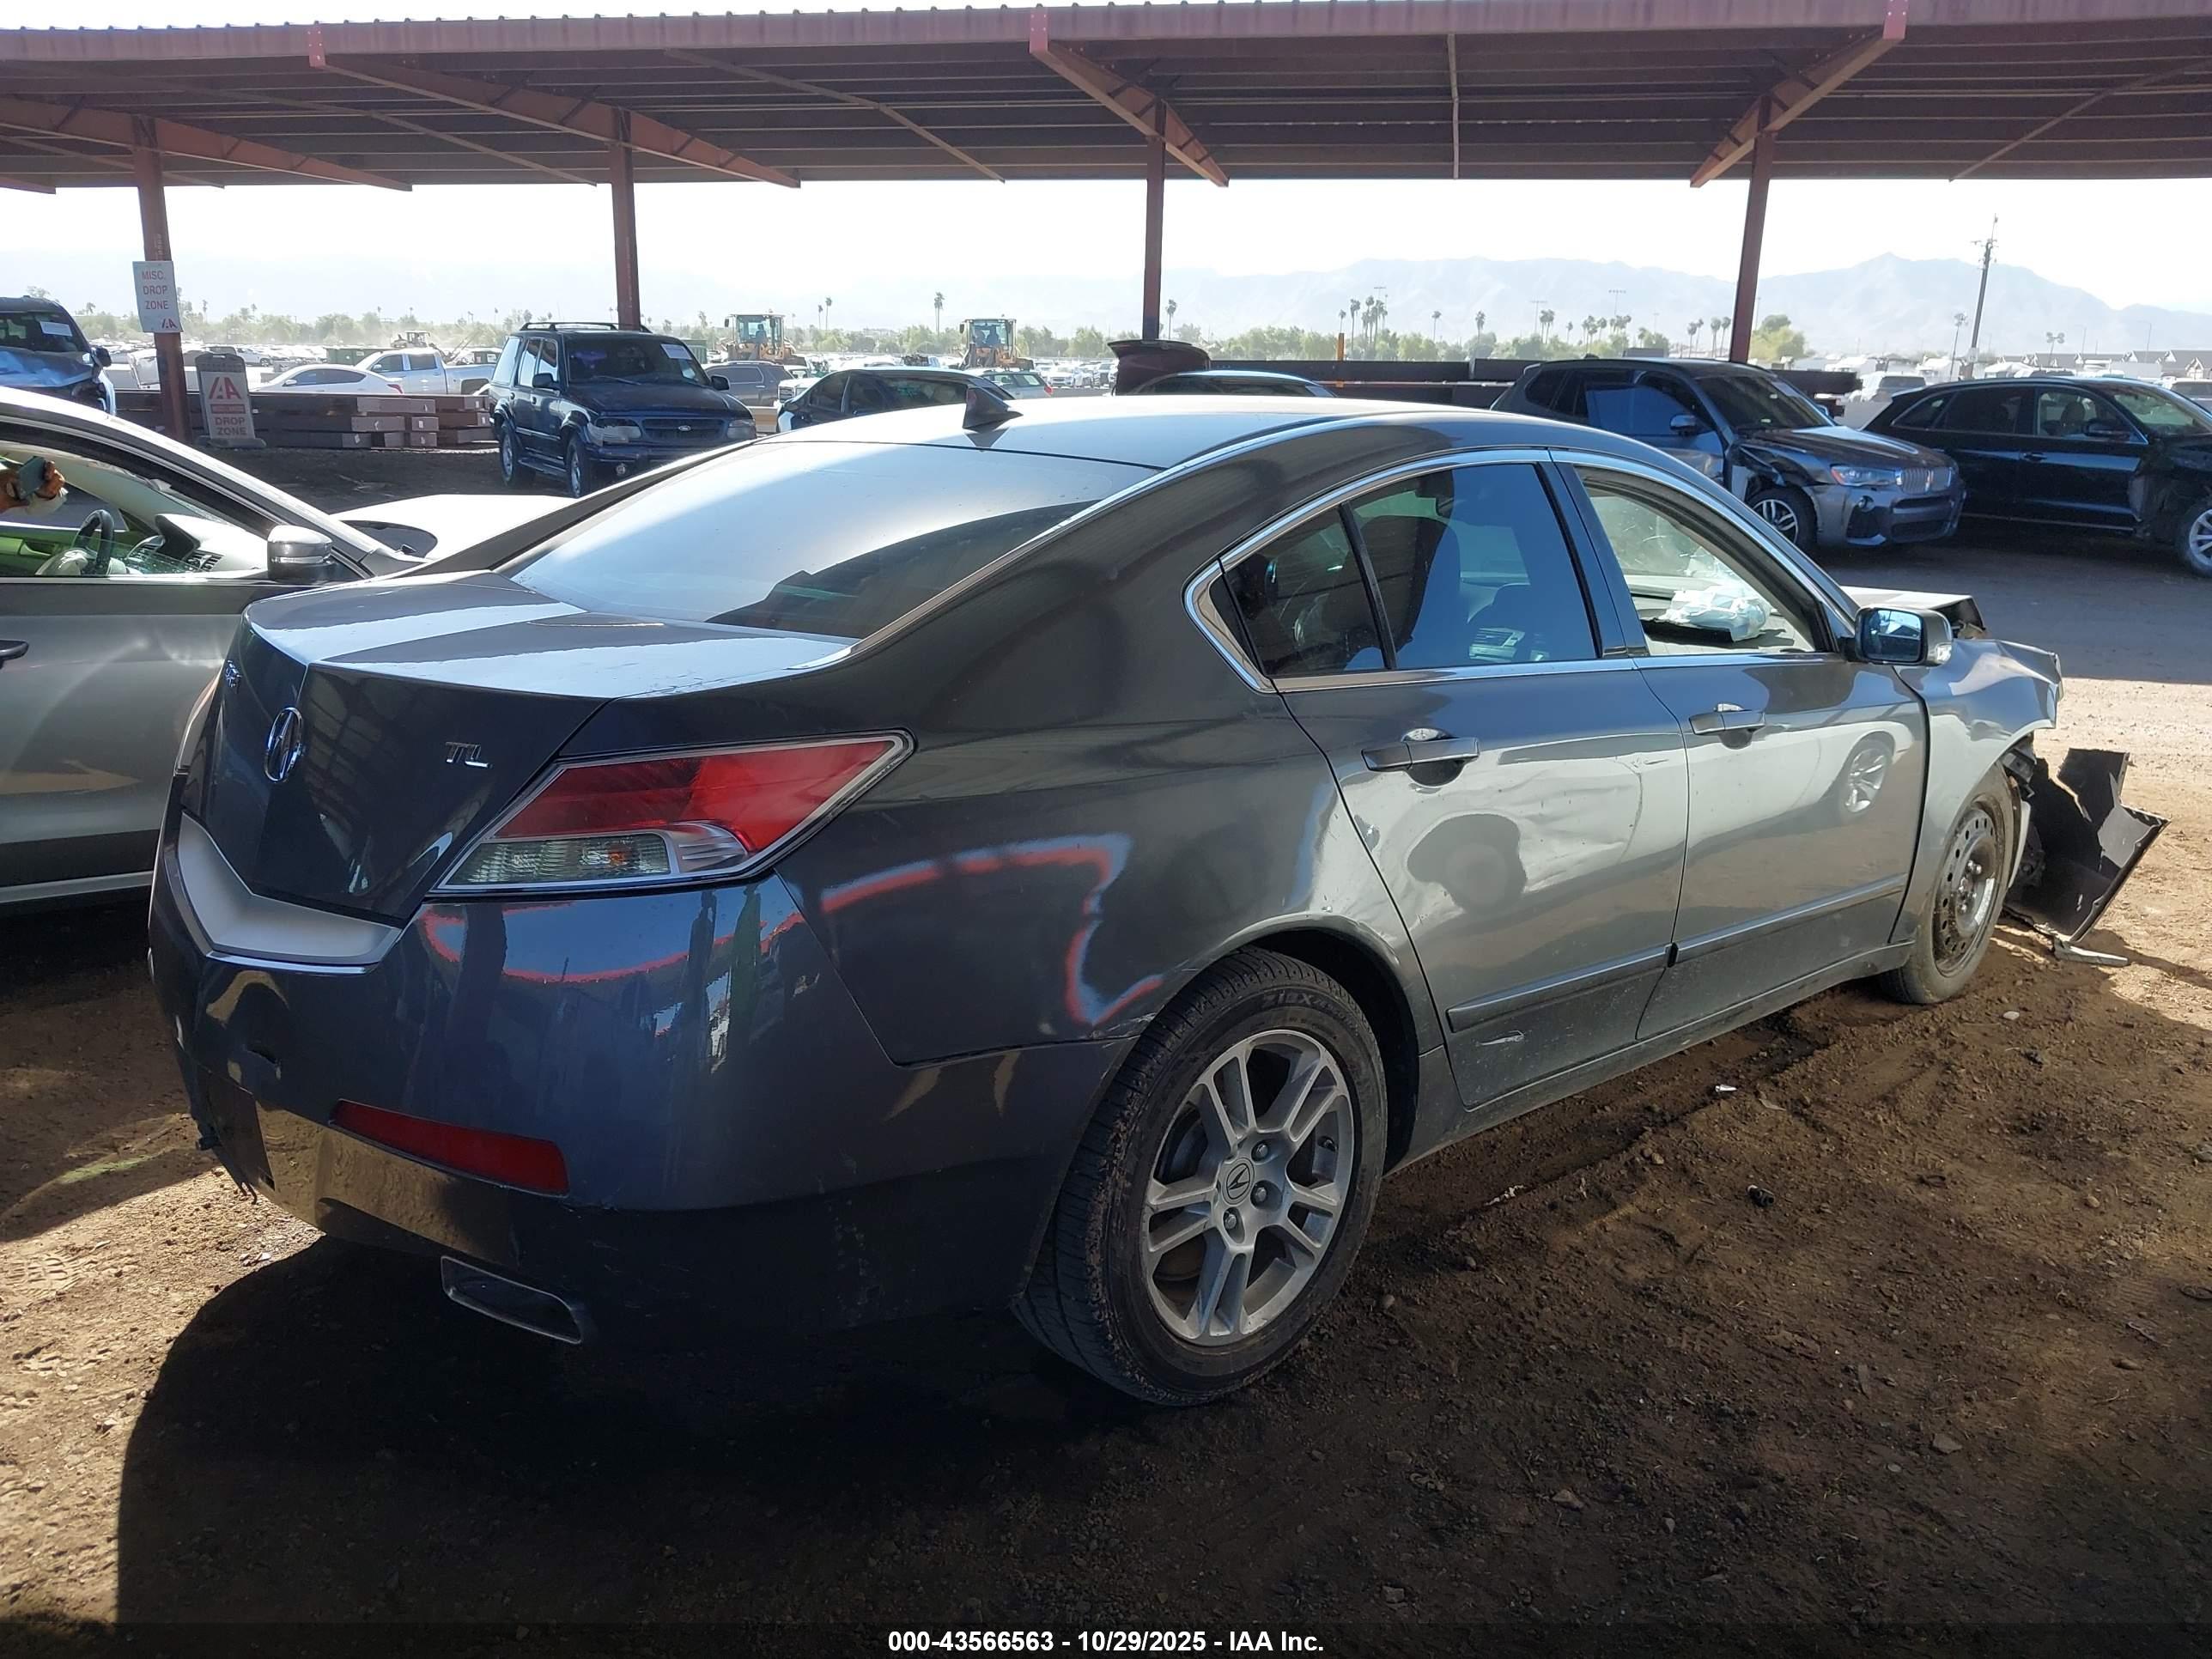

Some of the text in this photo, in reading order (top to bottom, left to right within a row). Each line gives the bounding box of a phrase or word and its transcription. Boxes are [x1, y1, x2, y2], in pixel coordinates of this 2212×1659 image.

[143, 285, 168, 295] DROP
[144, 301, 169, 310] ZONE
[215, 416, 246, 426] DROP
[216, 427, 247, 435] ZONE
[445, 741, 493, 768] TL
